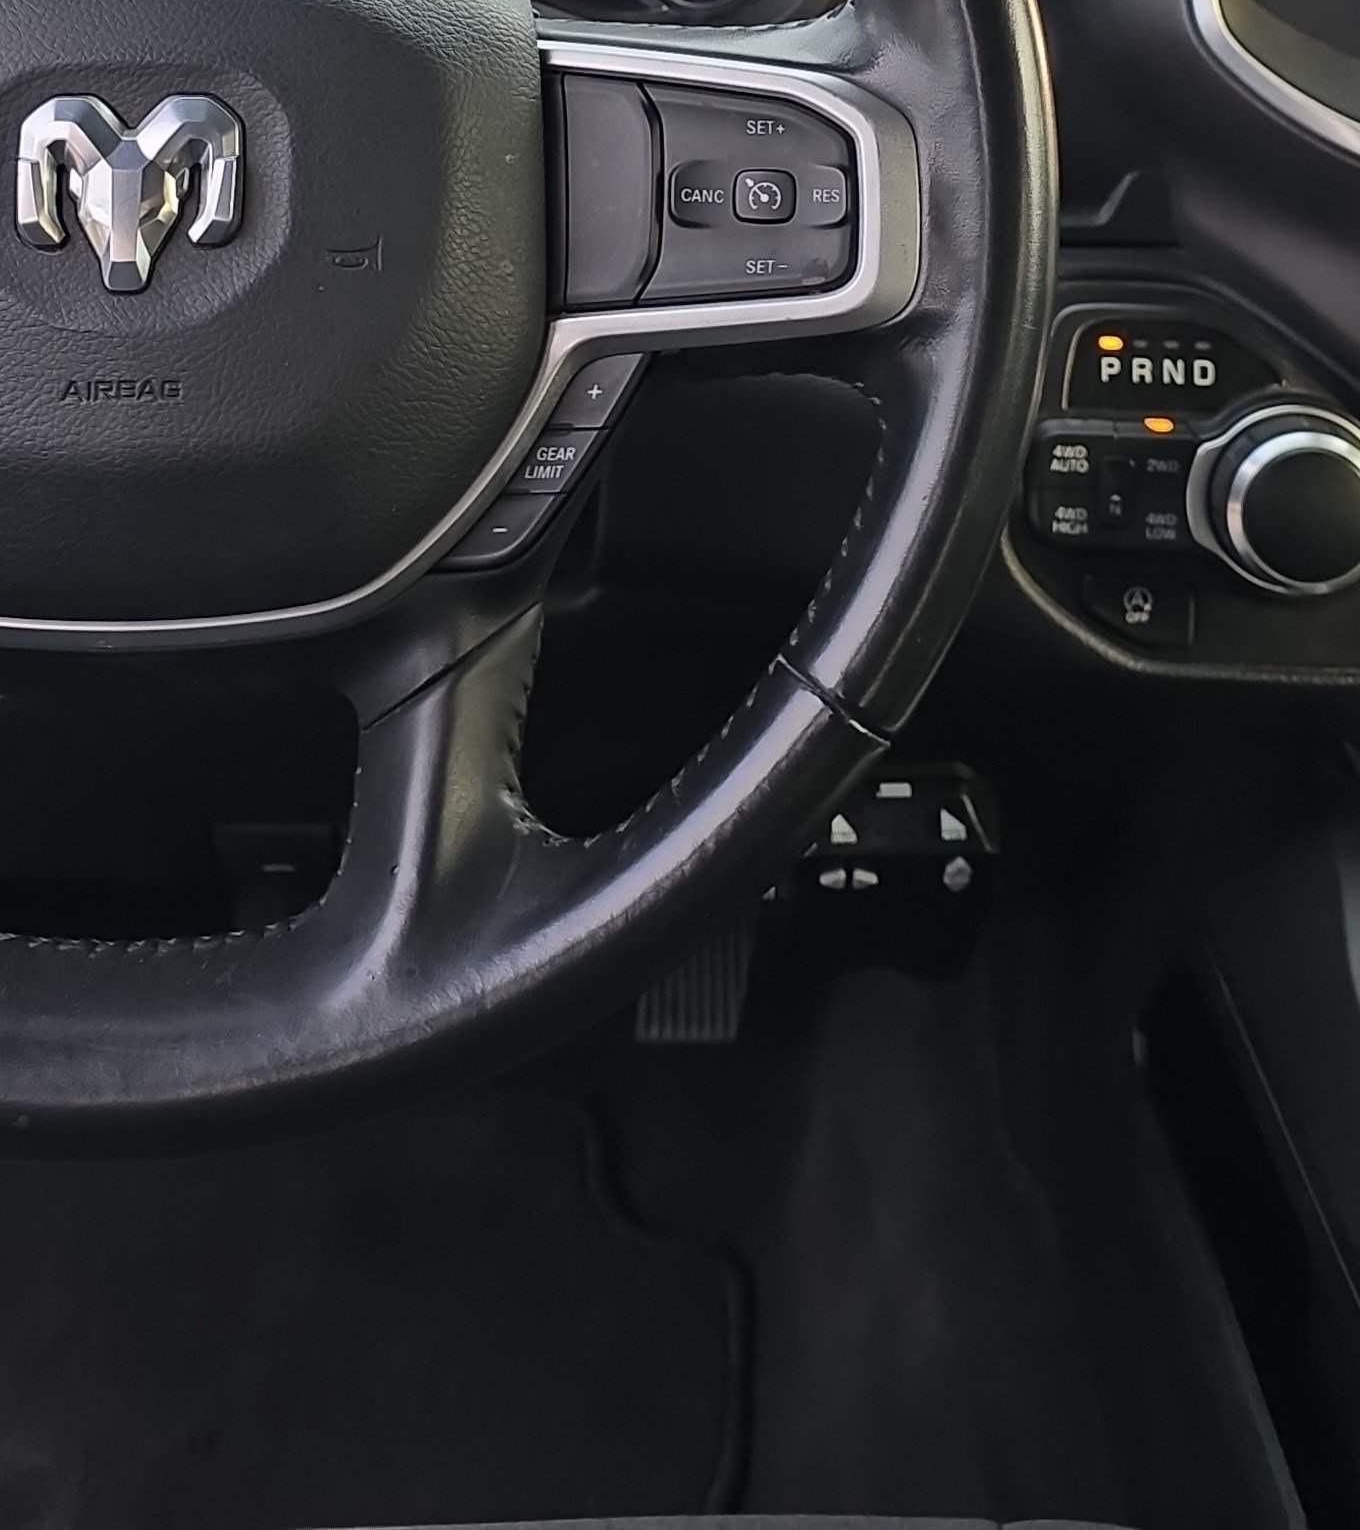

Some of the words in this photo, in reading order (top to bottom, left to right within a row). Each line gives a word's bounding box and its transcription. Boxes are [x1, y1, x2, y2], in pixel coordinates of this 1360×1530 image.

[745, 119, 786, 137] SET+
[680, 187, 725, 205] CANC
[812, 187, 841, 204] RES
[60, 379, 181, 403] AIRBAG
[536, 446, 577, 462] GEAR
[1052, 444, 1089, 459] 4WD
[524, 464, 565, 480] LIMIT
[1050, 457, 1090, 474] AUTO
[1054, 505, 1089, 521] 4WD
[1144, 512, 1178, 526] 4WD
[1052, 520, 1090, 535] HIGH
[1145, 526, 1178, 541] LOW
